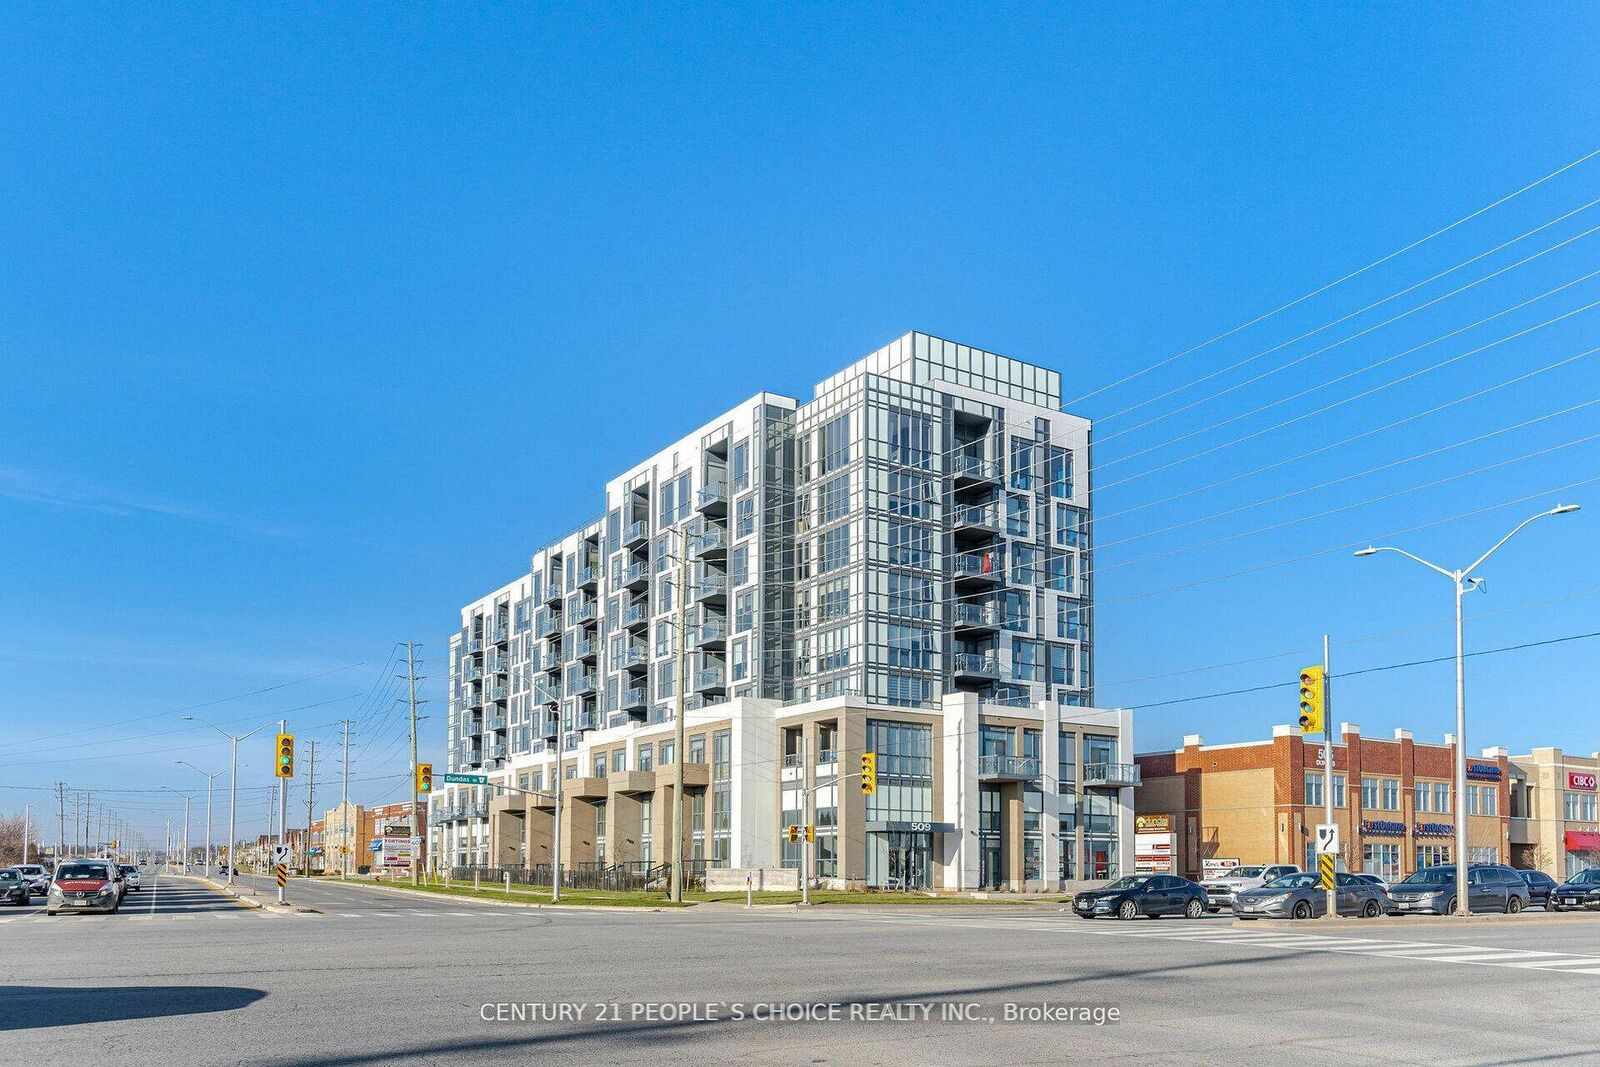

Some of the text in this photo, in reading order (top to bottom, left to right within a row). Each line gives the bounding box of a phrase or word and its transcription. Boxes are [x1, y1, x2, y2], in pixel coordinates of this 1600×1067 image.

[446, 775, 470, 783] Dundas
[1573, 775, 1589, 787] CIBC
[911, 822, 932, 831] 509
